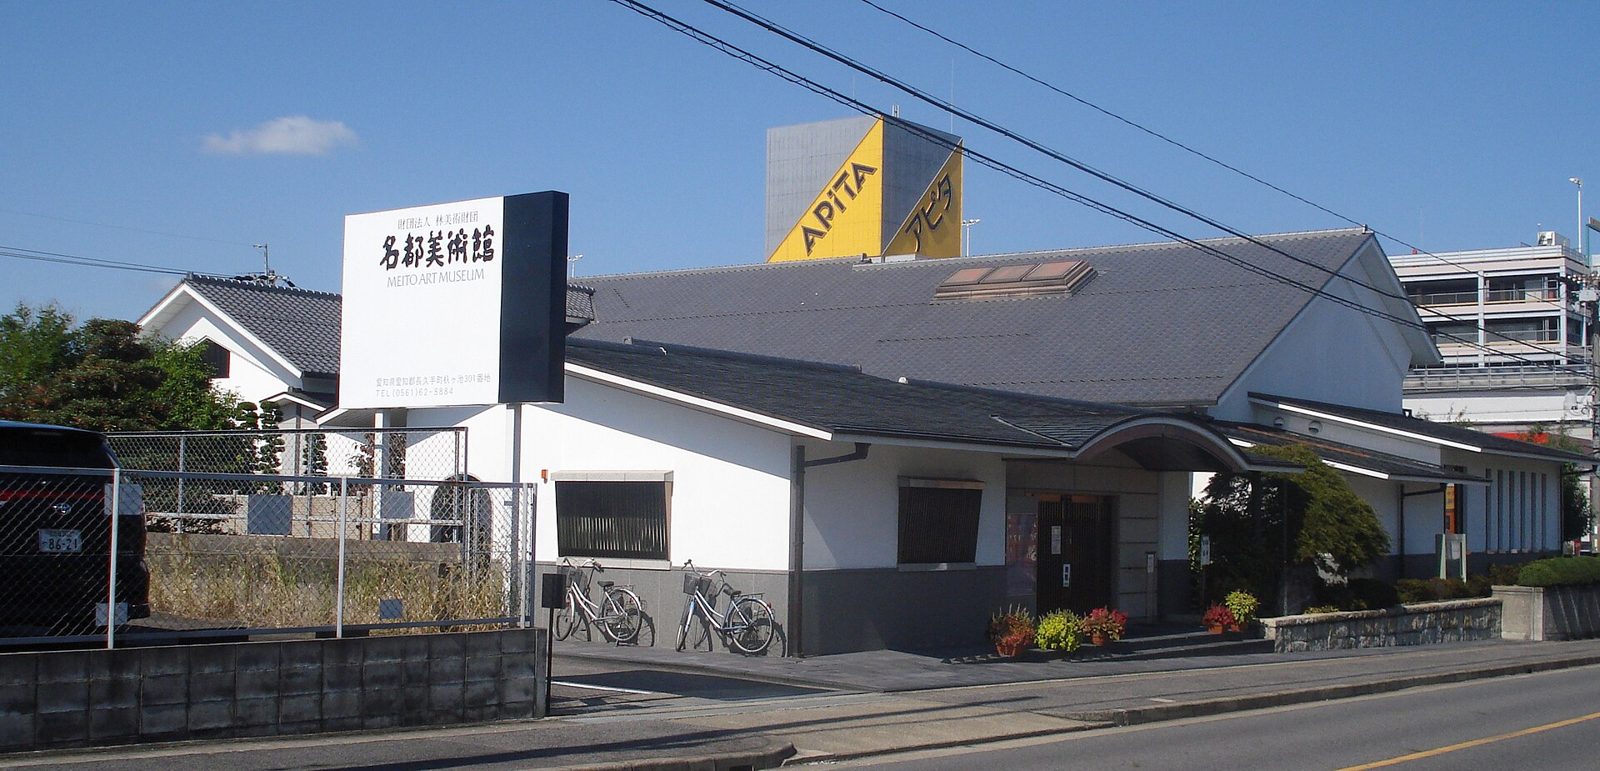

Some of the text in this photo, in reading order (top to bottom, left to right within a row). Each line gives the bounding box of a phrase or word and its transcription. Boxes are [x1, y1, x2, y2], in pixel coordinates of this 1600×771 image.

[398, 216, 430, 230] 財団法人
[801, 162, 878, 257] APITA
[905, 173, 951, 253] アピタ
[380, 224, 495, 271] 名都美術館
[387, 268, 485, 287] MEITO ART MUSEUM
